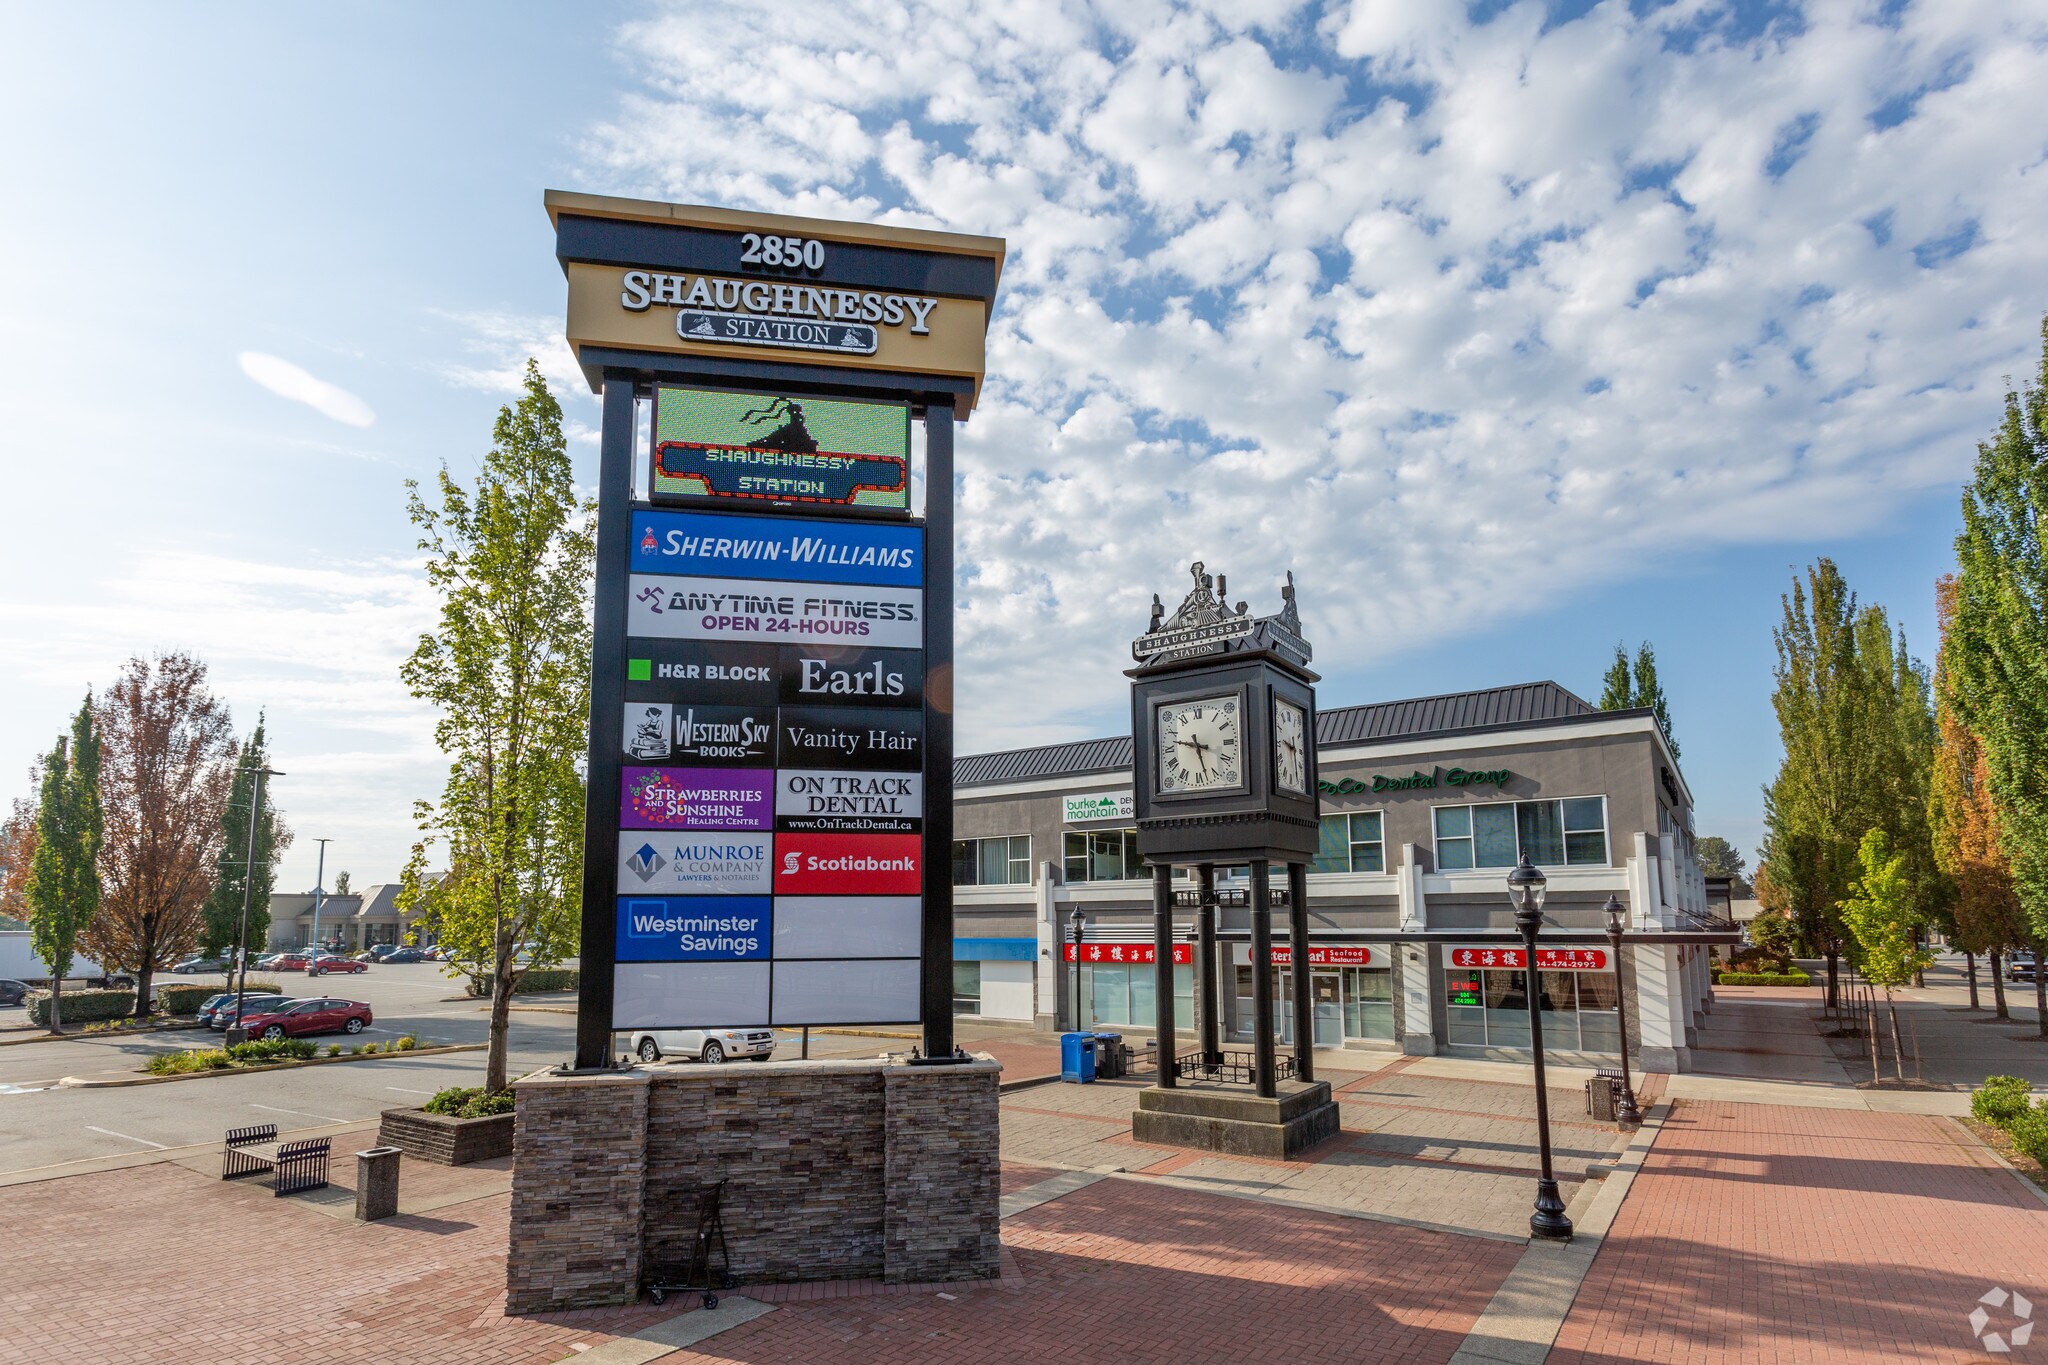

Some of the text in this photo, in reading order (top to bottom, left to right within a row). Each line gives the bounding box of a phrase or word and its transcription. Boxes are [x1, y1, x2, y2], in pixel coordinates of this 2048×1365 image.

[740, 232, 825, 270] 2850
[621, 271, 938, 334] SHAUGHNESSY
[726, 318, 831, 344] STATION
[705, 448, 856, 471] SHAUGHNESSY
[738, 476, 825, 494] STATION
[662, 529, 914, 569] SHERWIN-WILLIAMS
[668, 591, 794, 616] ANYTIME
[701, 615, 870, 636] OPEN 24-HOURS
[1146, 623, 1241, 648] SHAUGHNESSY
[1173, 644, 1214, 659] STATION
[658, 663, 771, 682] H&R BLOCK
[798, 658, 905, 696] Earls
[787, 727, 917, 755] Vanity Hair
[700, 746, 746, 758] BOOKS
[788, 776, 912, 795] ON TRACK
[1318, 765, 1511, 796] PoCo Dental Group
[644, 785, 762, 802] STRAWBERRIES
[666, 801, 744, 817] SUNSHINE
[807, 796, 903, 814] DENTAL
[1067, 797, 1134, 810] burke DEN
[1067, 806, 1119, 819] mountain
[687, 817, 759, 826] HEALING CENTRE
[788, 818, 912, 830] www.OnTrackDental.ca
[674, 845, 765, 861] MUNROE
[673, 861, 763, 873] & COMPANY
[807, 855, 915, 871] Scotiabank
[633, 915, 759, 933] Westminster
[681, 934, 759, 956] Savings
[1330, 949, 1363, 957] Seafood
[1308, 950, 1325, 962] arl
[1537, 961, 1596, 969] 04-474-2992
